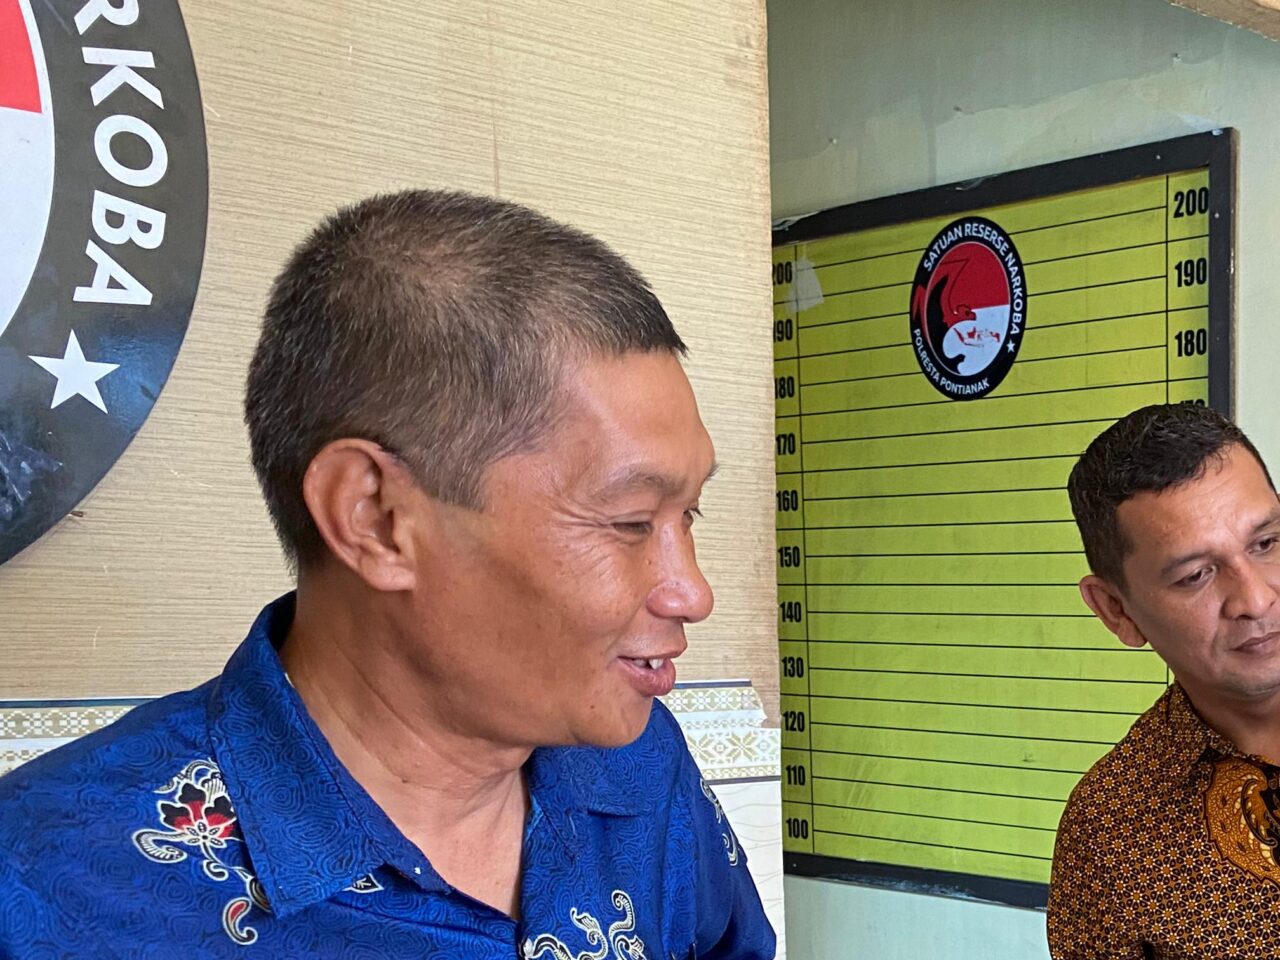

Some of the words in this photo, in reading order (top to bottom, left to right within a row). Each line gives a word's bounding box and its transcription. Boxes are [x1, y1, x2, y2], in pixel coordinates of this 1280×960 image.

[72, 0, 169, 306] RKOBA
[1173, 187, 1209, 218] 200
[923, 224, 963, 272] SATUAN
[964, 223, 1010, 256] RESERSE
[1004, 254, 1023, 335] NARKOBA
[1174, 257, 1207, 288] 190
[1174, 328, 1208, 357] 180
[913, 328, 940, 383] POLRESTA
[939, 377, 991, 395] PONTIANAK
[776, 433, 796, 456] 170
[776, 489, 799, 512] 160
[778, 546, 801, 568] 150
[779, 601, 802, 624] 140
[781, 656, 804, 679] 130
[782, 710, 806, 733] 120
[785, 764, 806, 787] 110
[786, 818, 809, 840] 100
